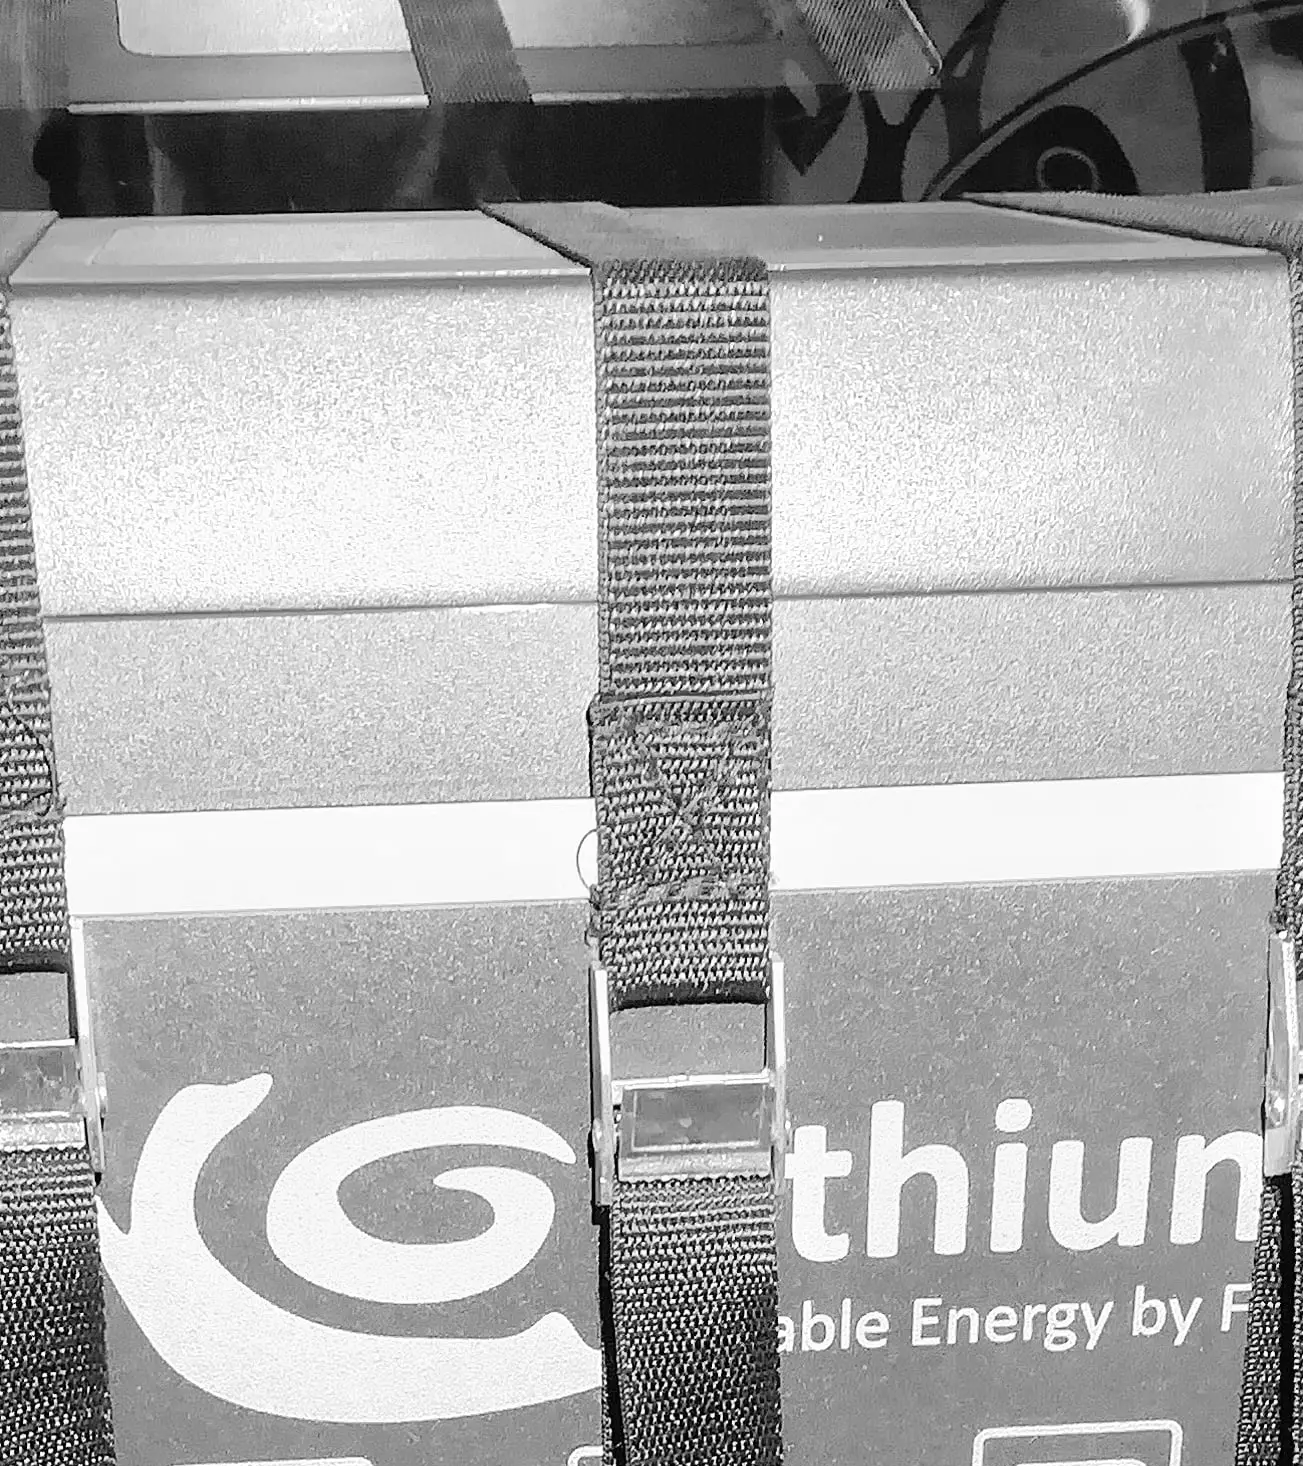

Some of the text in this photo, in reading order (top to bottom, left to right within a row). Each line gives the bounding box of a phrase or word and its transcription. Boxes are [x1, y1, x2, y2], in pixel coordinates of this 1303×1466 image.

[784, 1098, 1264, 1262] thium
[777, 1299, 889, 1353] able
[911, 1297, 1113, 1352] Energy
[1131, 1284, 1203, 1346] by
